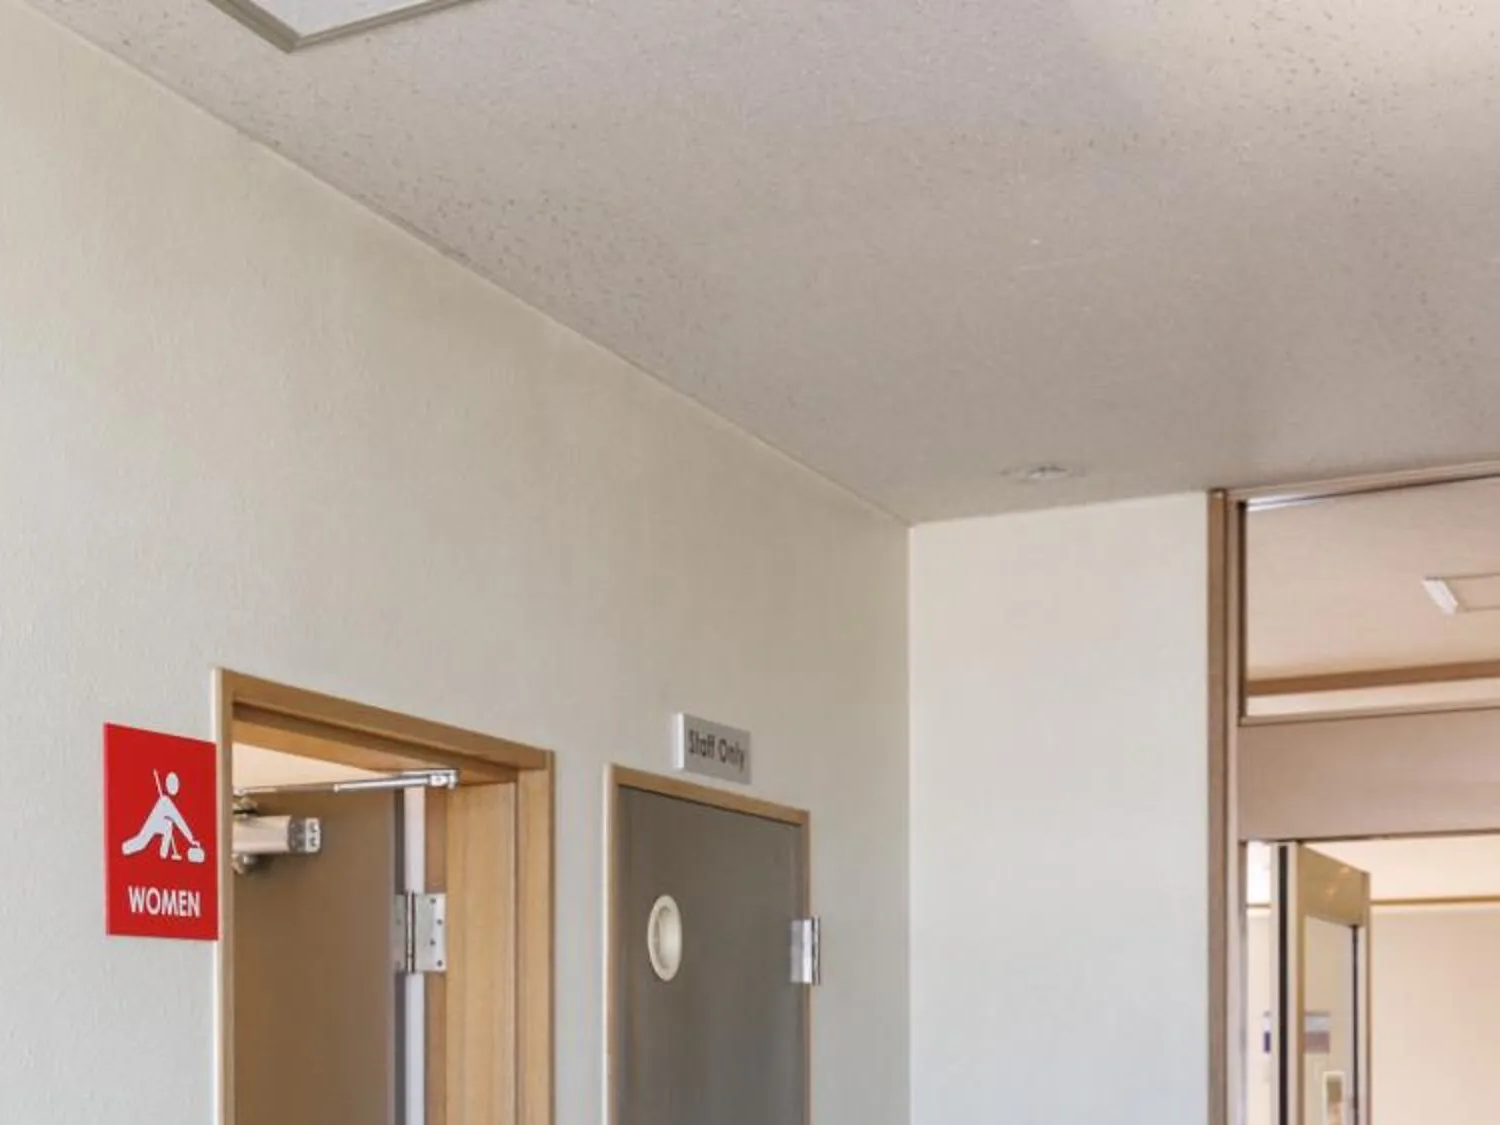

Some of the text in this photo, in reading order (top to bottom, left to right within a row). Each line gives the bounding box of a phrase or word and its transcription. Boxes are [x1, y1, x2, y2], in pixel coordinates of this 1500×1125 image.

[688, 729, 745, 773] Staff Only
[127, 885, 201, 918] WOMEN
